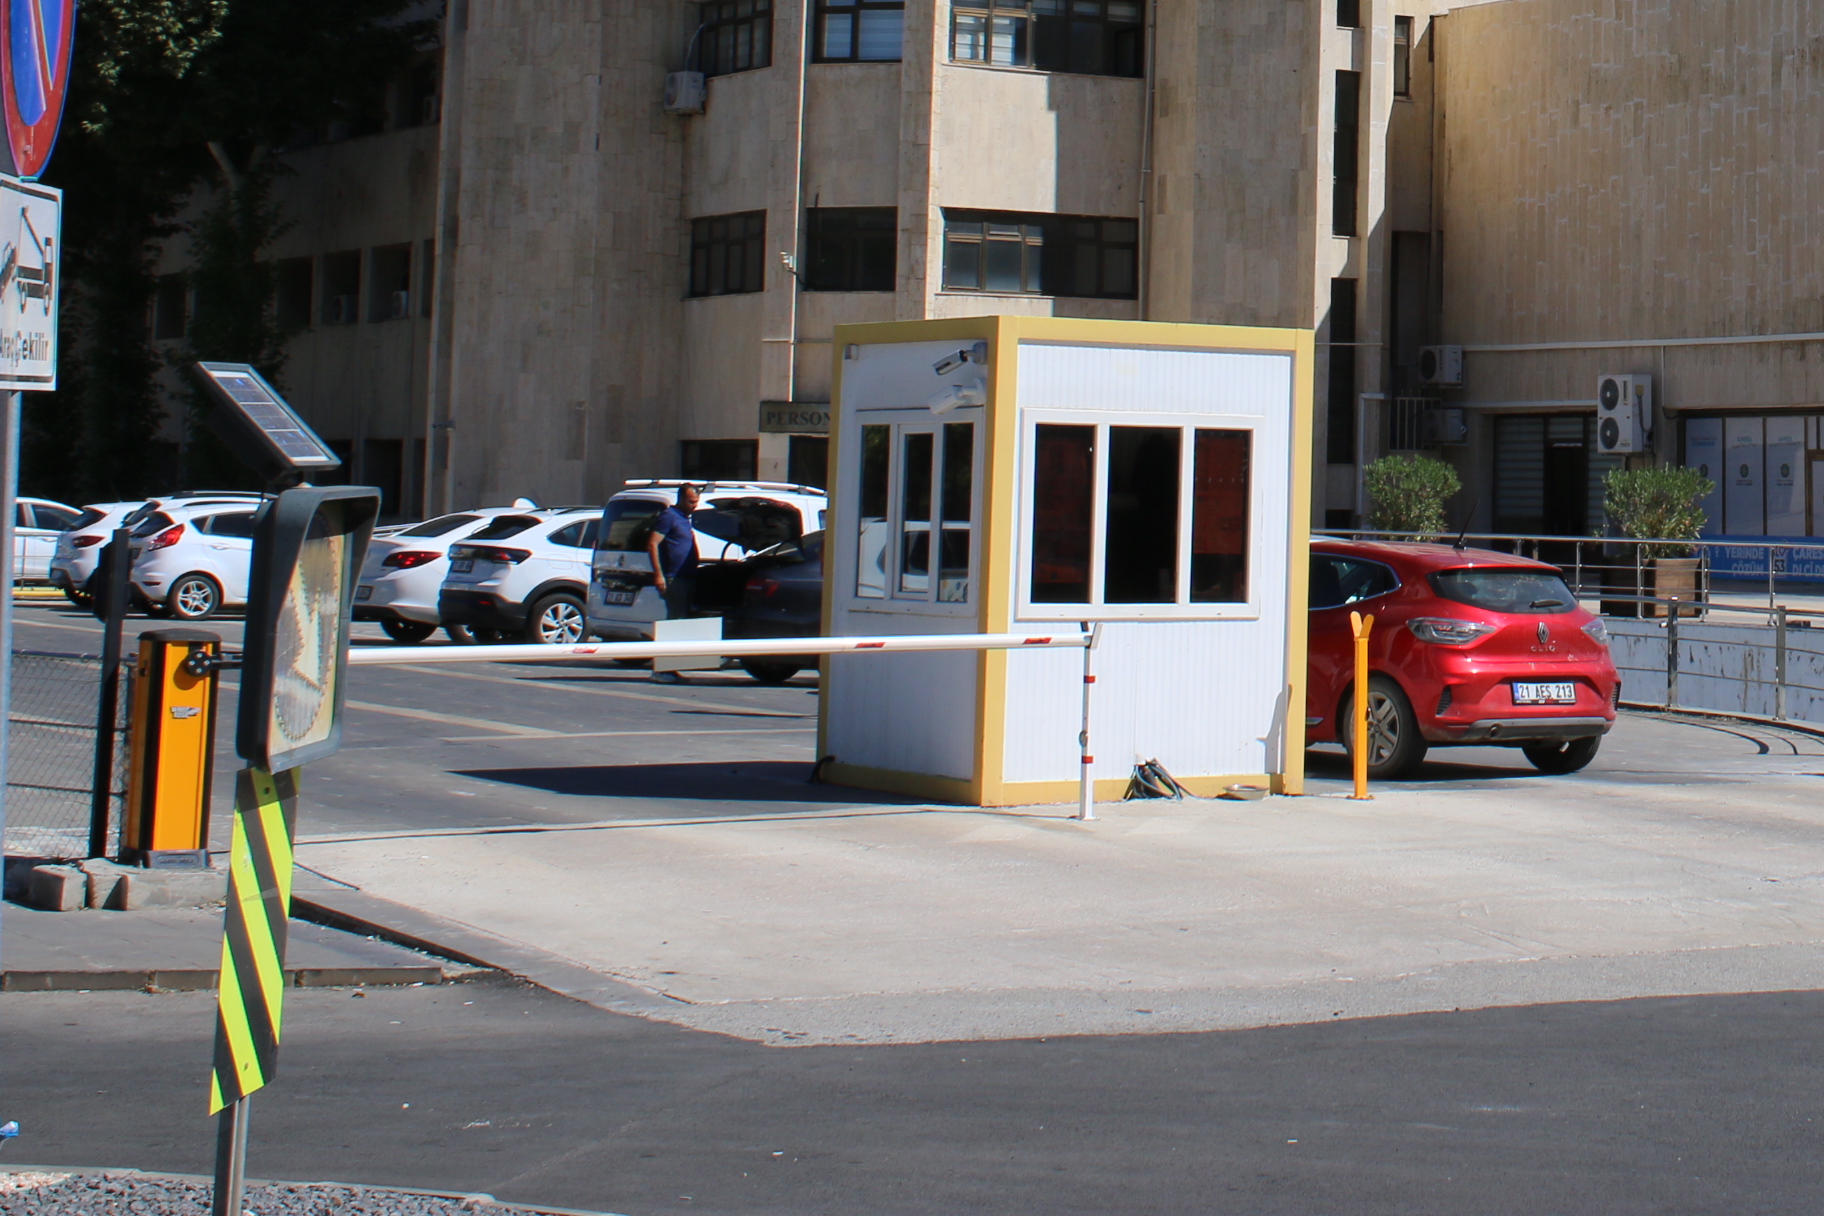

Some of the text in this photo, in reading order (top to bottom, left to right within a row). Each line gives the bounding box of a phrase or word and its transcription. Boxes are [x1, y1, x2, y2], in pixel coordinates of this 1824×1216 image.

[1519, 684, 1573, 698] 21 AES 213
